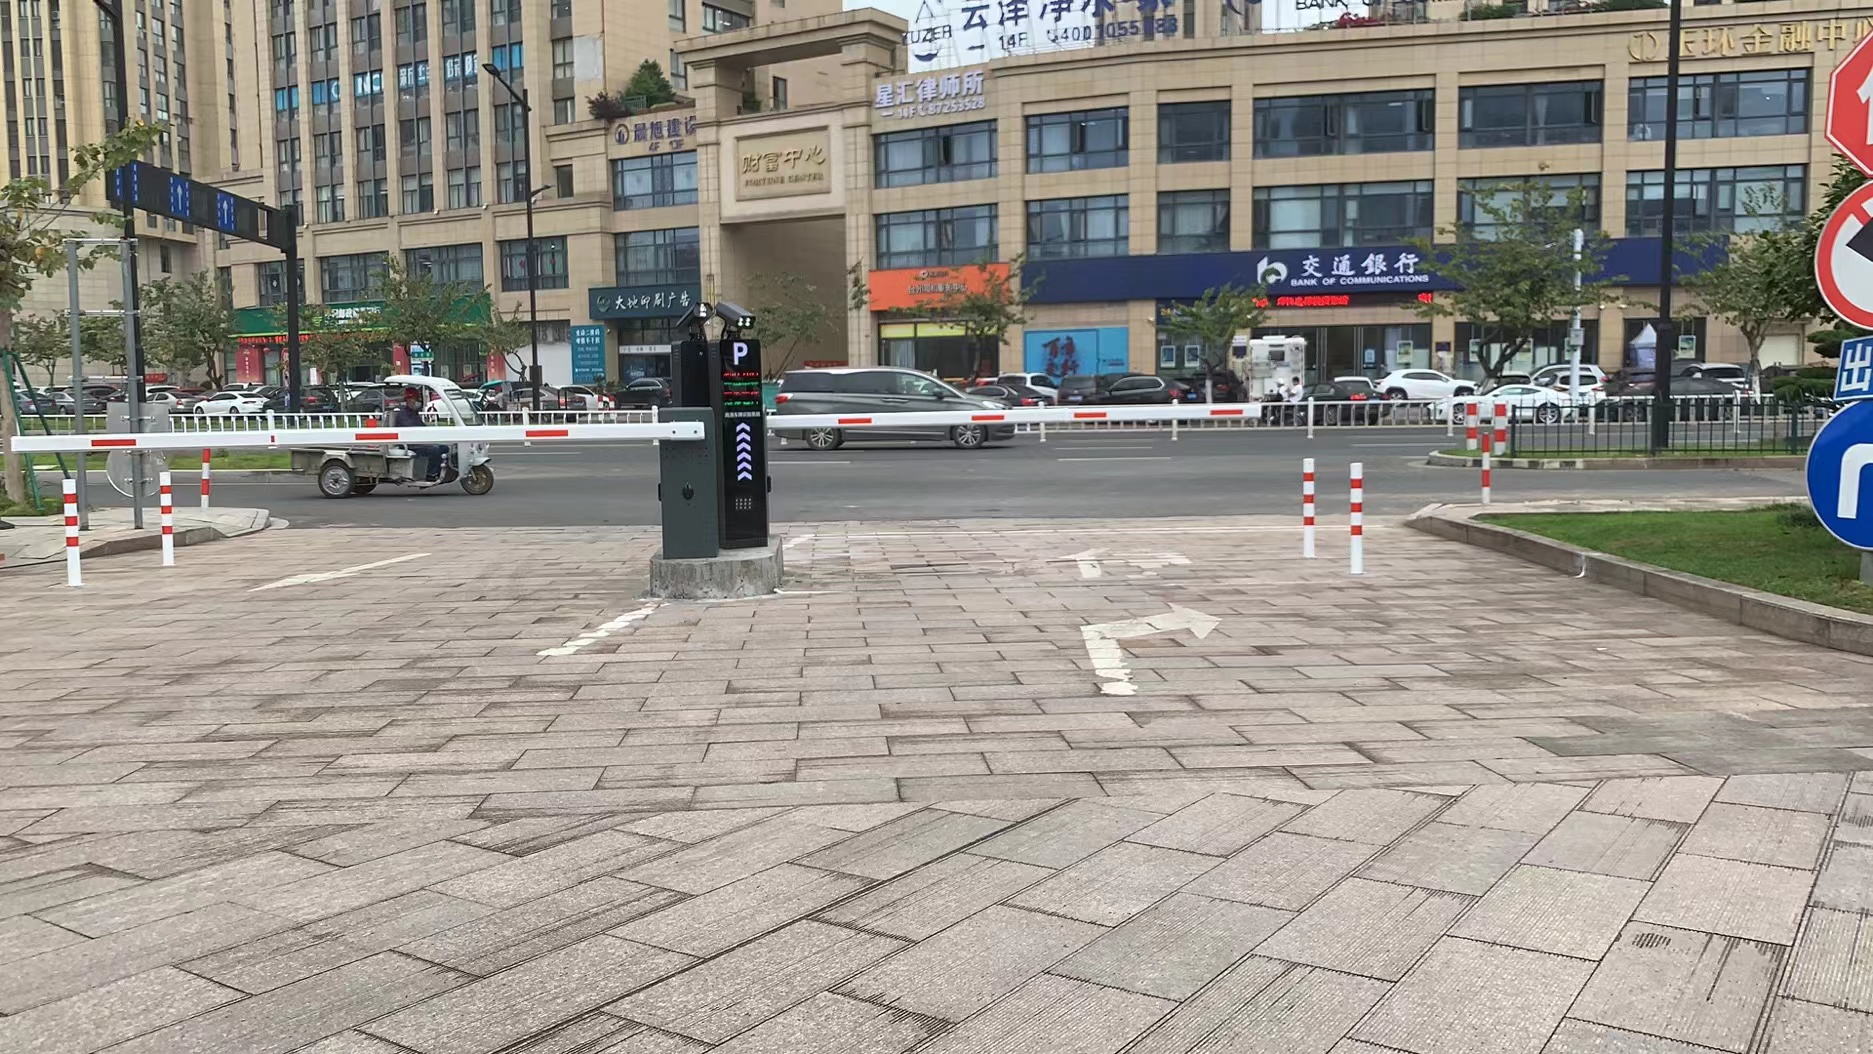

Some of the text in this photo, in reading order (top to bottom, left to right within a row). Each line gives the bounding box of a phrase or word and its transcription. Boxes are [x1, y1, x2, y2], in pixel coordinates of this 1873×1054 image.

[875, 71, 985, 109] 星汇律师所
[743, 145, 826, 174] 财富中心
[1291, 274, 1430, 287] BANK OF COMMUNICATIONS
[615, 290, 691, 310] 大地印刷广告
[733, 342, 748, 365] P
